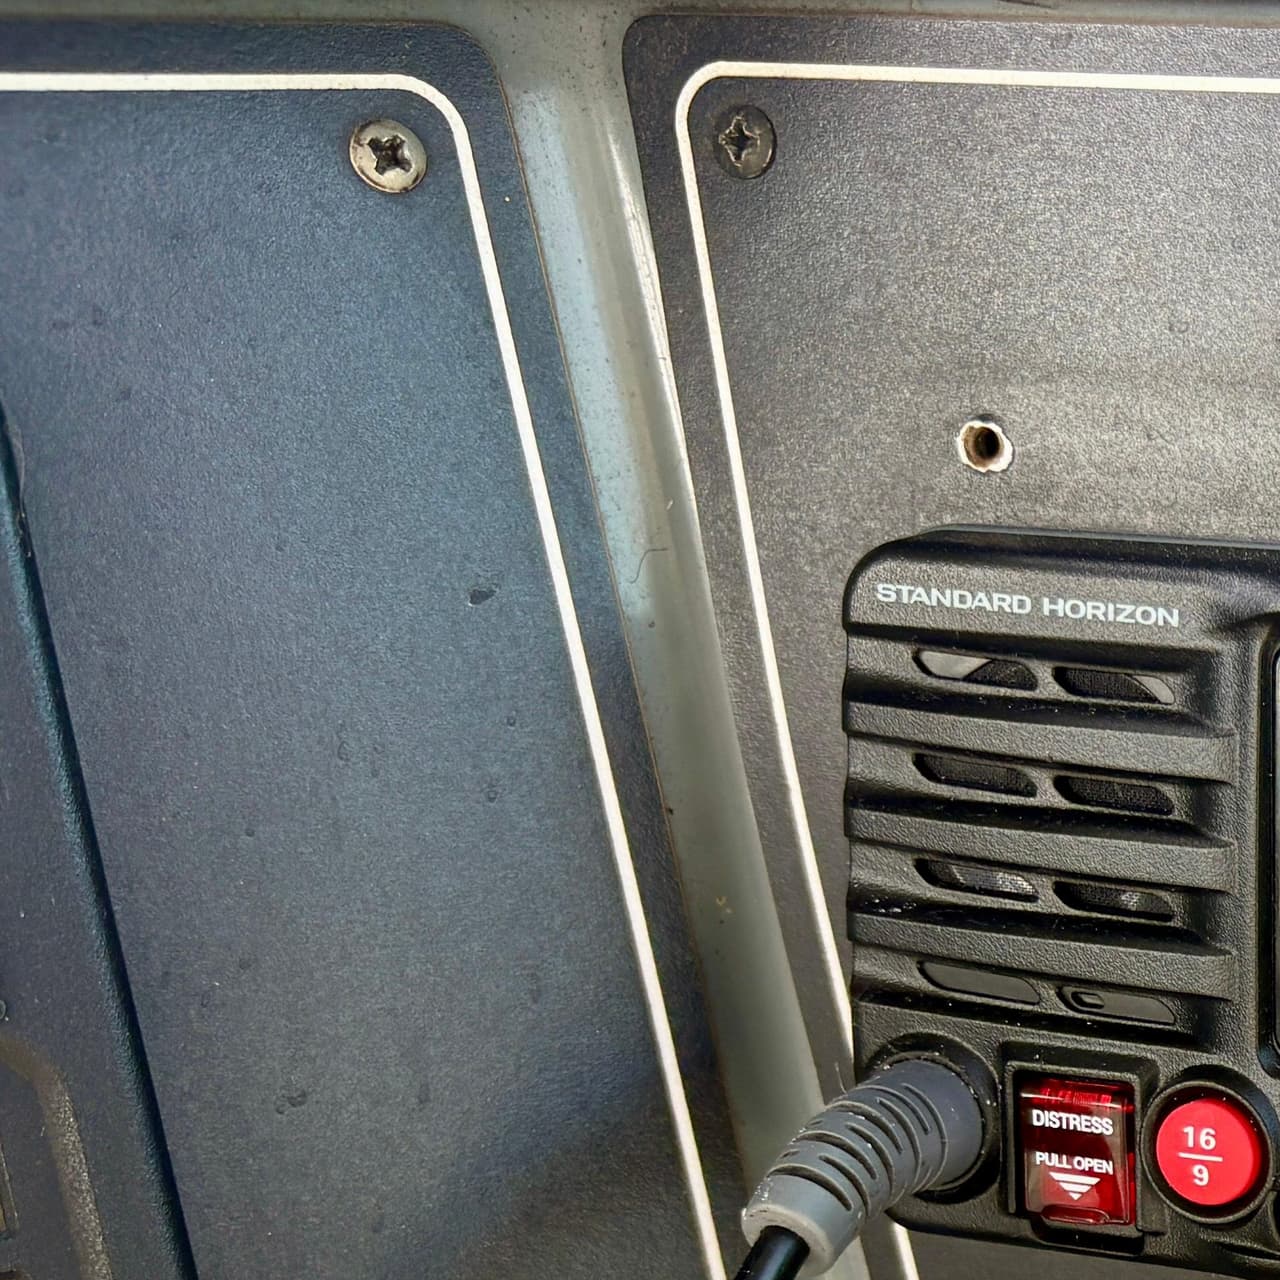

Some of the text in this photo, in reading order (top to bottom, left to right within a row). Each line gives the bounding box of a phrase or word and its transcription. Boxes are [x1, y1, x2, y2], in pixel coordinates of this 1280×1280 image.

[876, 583, 1180, 628] STANDARD HORIZON
[1032, 1109, 1114, 1136] DISTRESS
[1182, 1126, 1217, 1150] 16
[1035, 1151, 1114, 1175] PULL OPEN
[1192, 1164, 1210, 1186] 9
